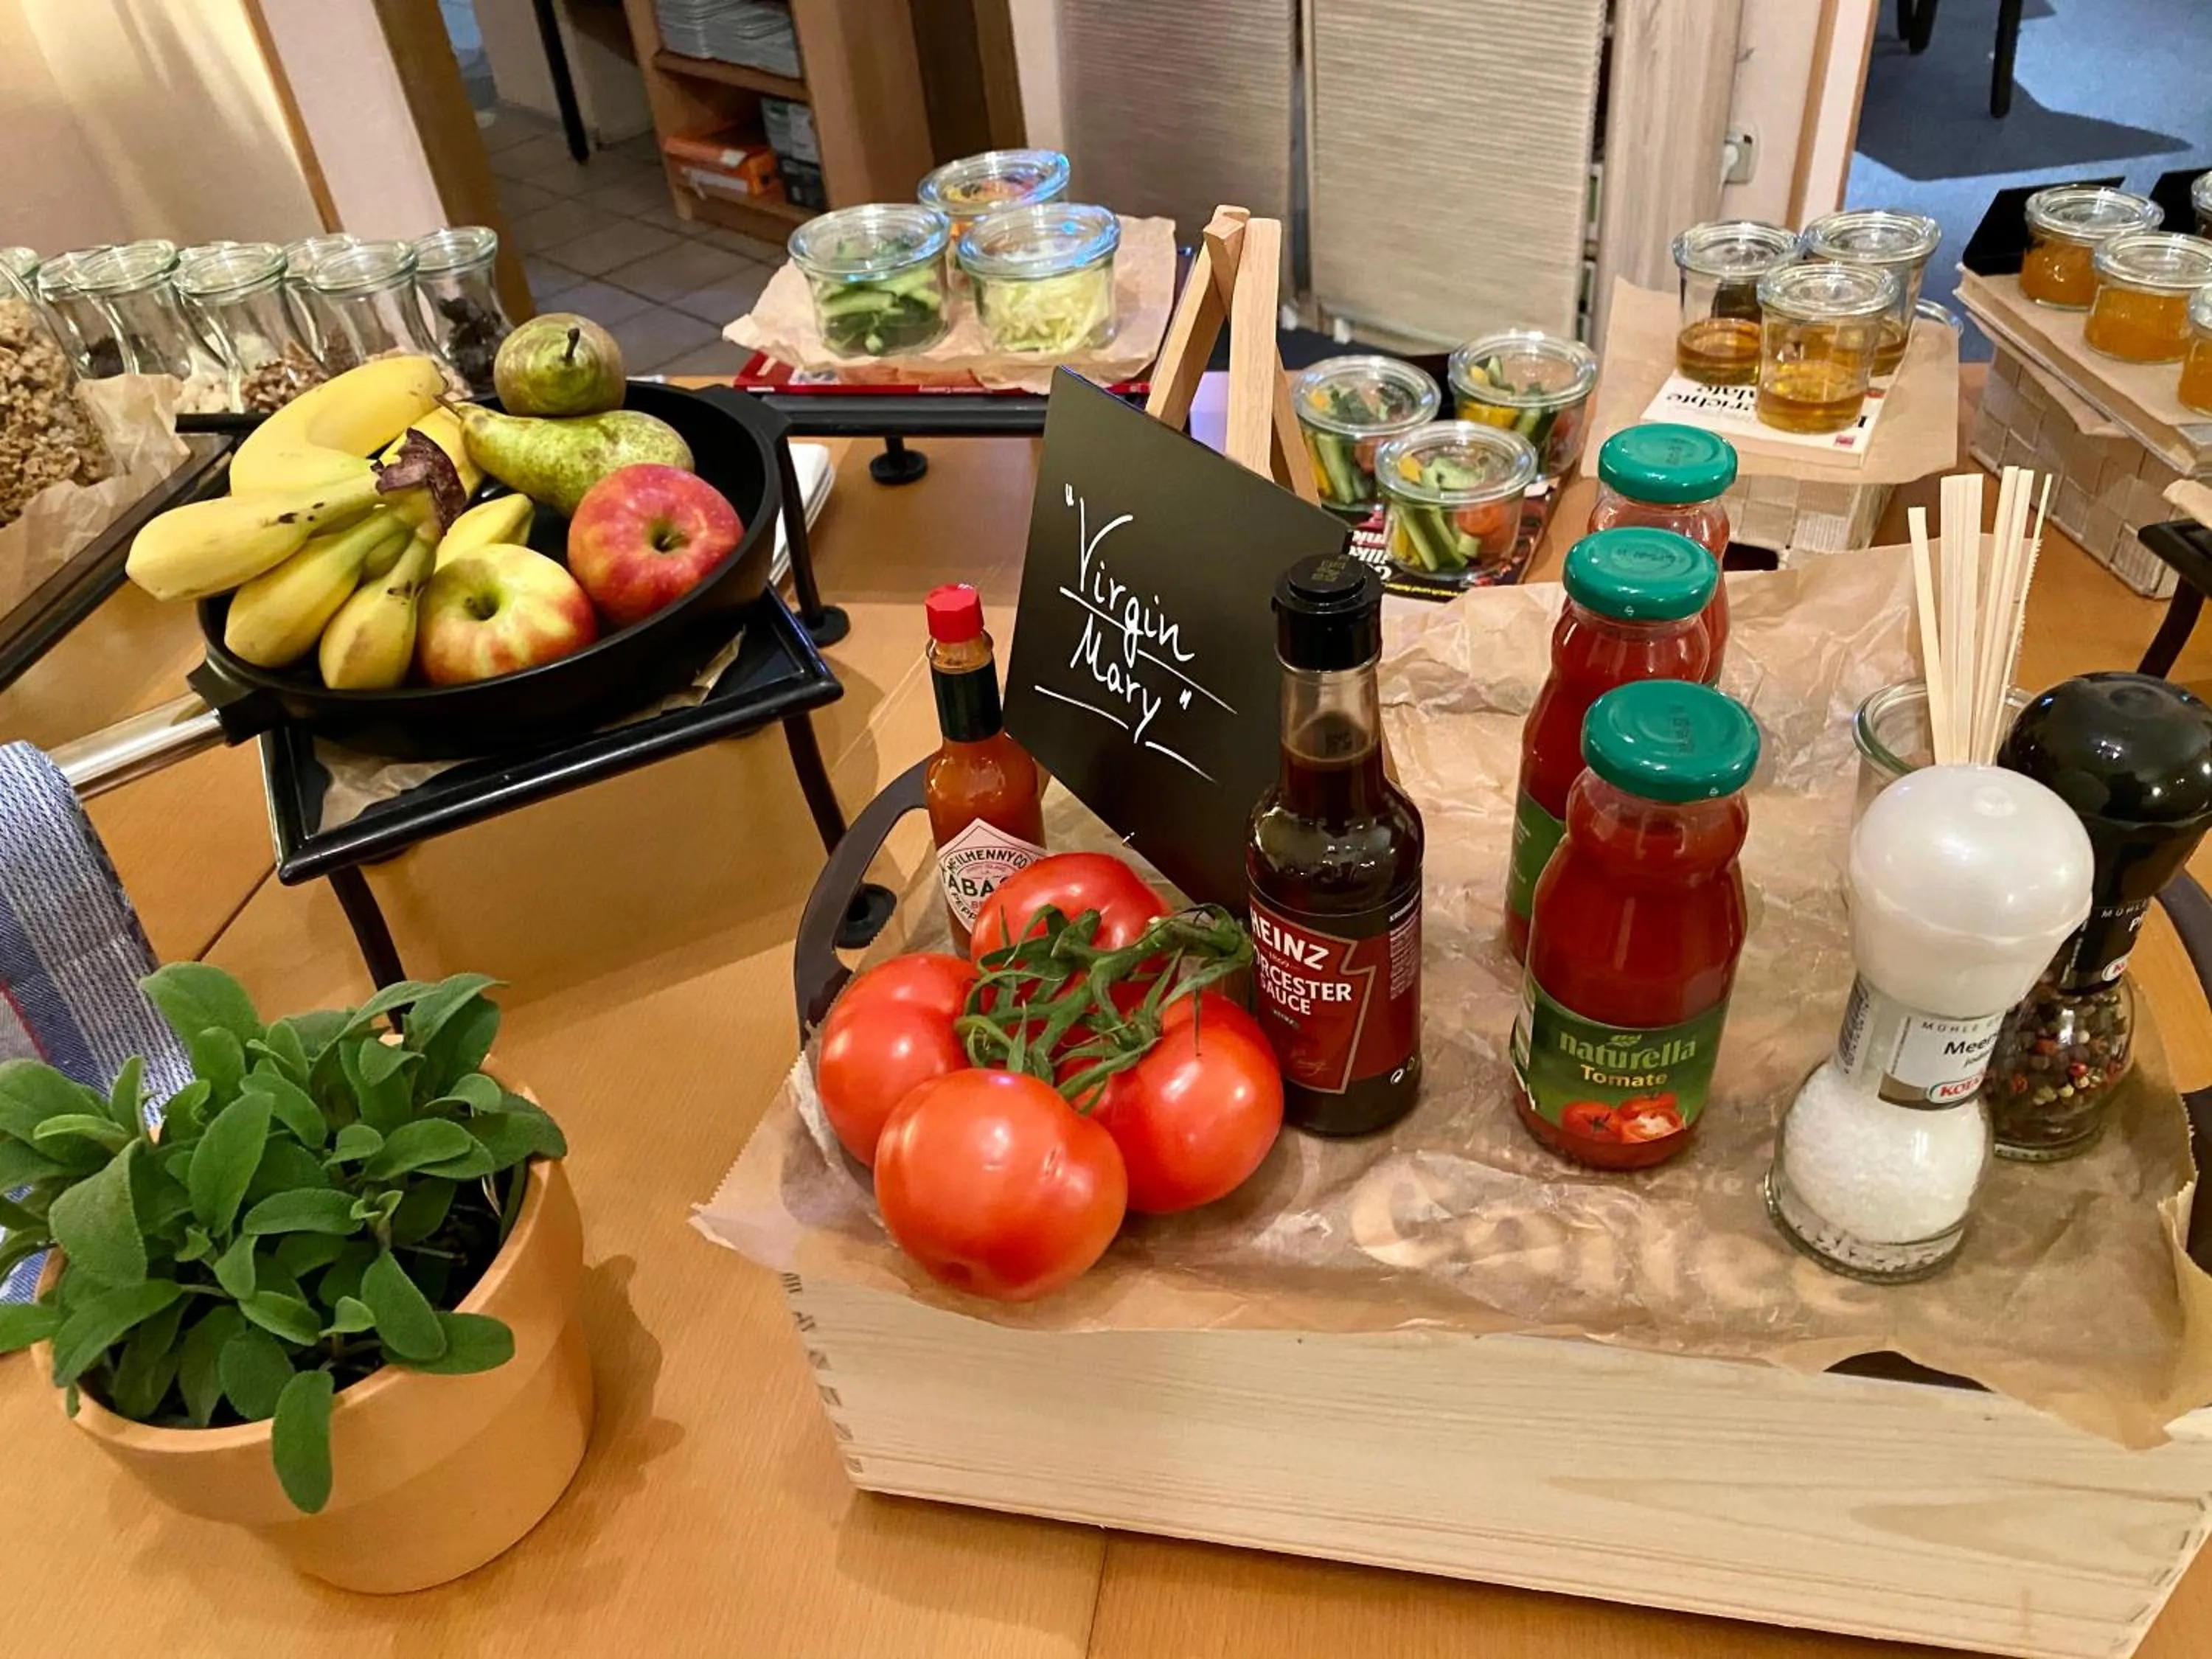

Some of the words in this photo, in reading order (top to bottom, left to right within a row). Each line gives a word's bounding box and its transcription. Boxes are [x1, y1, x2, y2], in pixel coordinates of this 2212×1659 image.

[1250, 905, 1329, 971] HEINZ
[1260, 972, 1312, 1016] SAUCE
[1559, 1032, 1696, 1070] naturella
